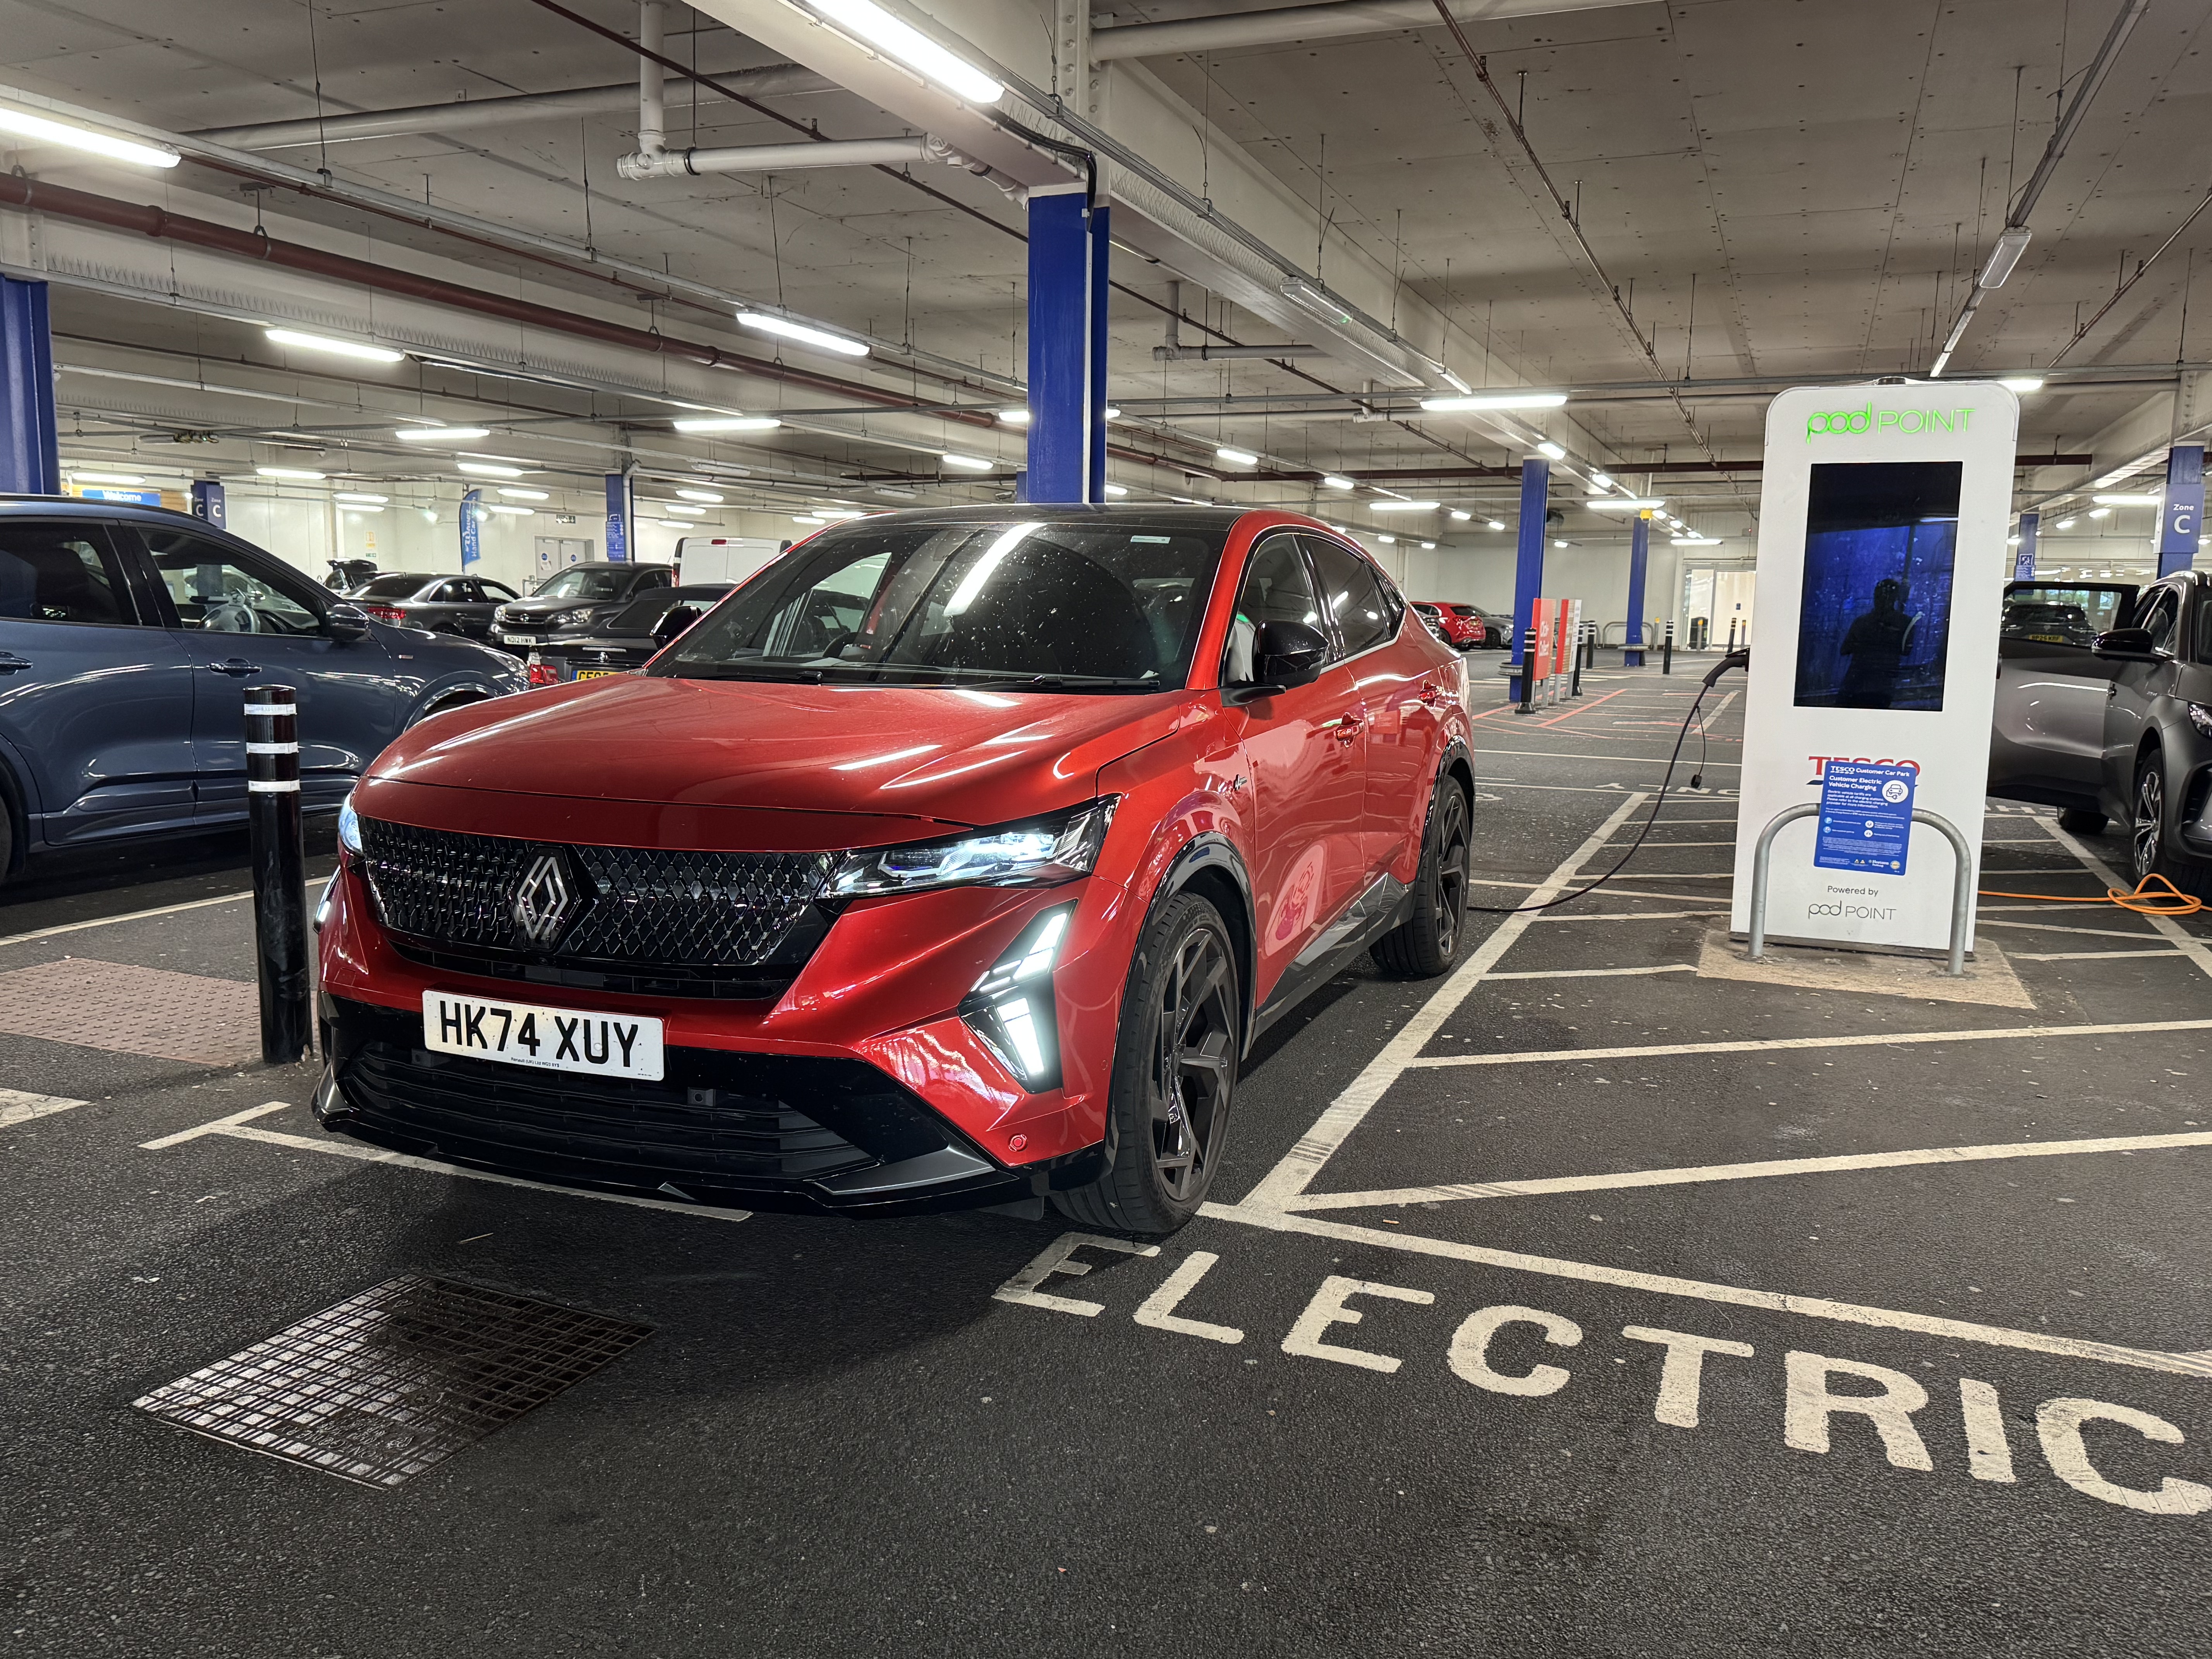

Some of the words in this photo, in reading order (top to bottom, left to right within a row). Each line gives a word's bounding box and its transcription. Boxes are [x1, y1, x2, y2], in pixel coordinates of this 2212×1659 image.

[1806, 400, 1872, 445] pod
[1878, 409, 1976, 434] POINT
[196, 504, 204, 516] C
[213, 505, 222, 517] C
[2174, 515, 2190, 534] C
[1851, 783, 1877, 792] Charging
[1827, 886, 1865, 894] Powered
[1869, 888, 1879, 897] by
[1808, 900, 1842, 919] pod
[1845, 906, 1897, 920] POINT
[440, 1000, 541, 1056] HK74
[555, 1015, 638, 1068] XUY
[991, 1232, 2212, 1515] ELECTRIC
